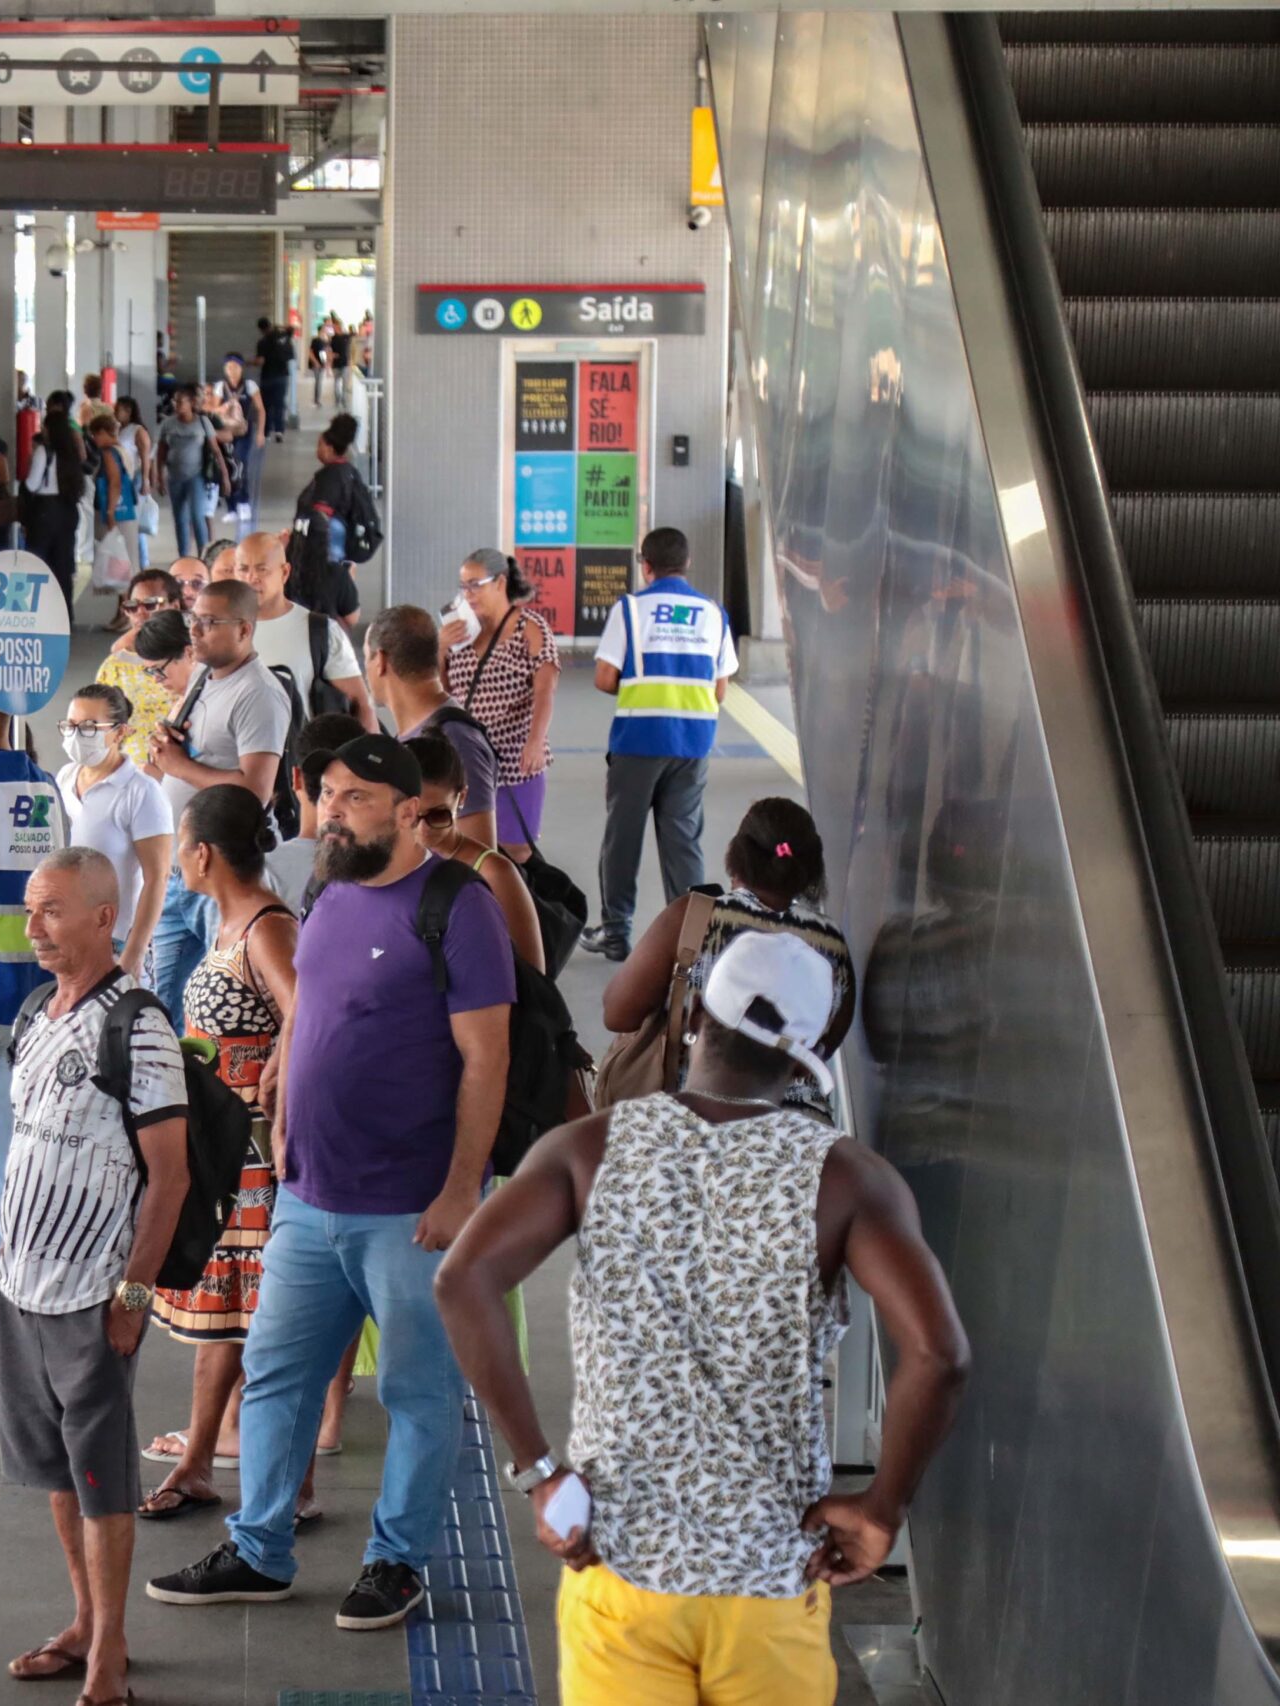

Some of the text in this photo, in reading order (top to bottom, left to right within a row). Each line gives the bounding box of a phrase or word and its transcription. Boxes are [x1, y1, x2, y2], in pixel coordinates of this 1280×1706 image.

[578, 296, 655, 322] Saída
[589, 371, 632, 393] FALA
[589, 422, 623, 444] RIO!
[584, 489, 631, 508] PARTIU
[650, 604, 704, 626] BRT
